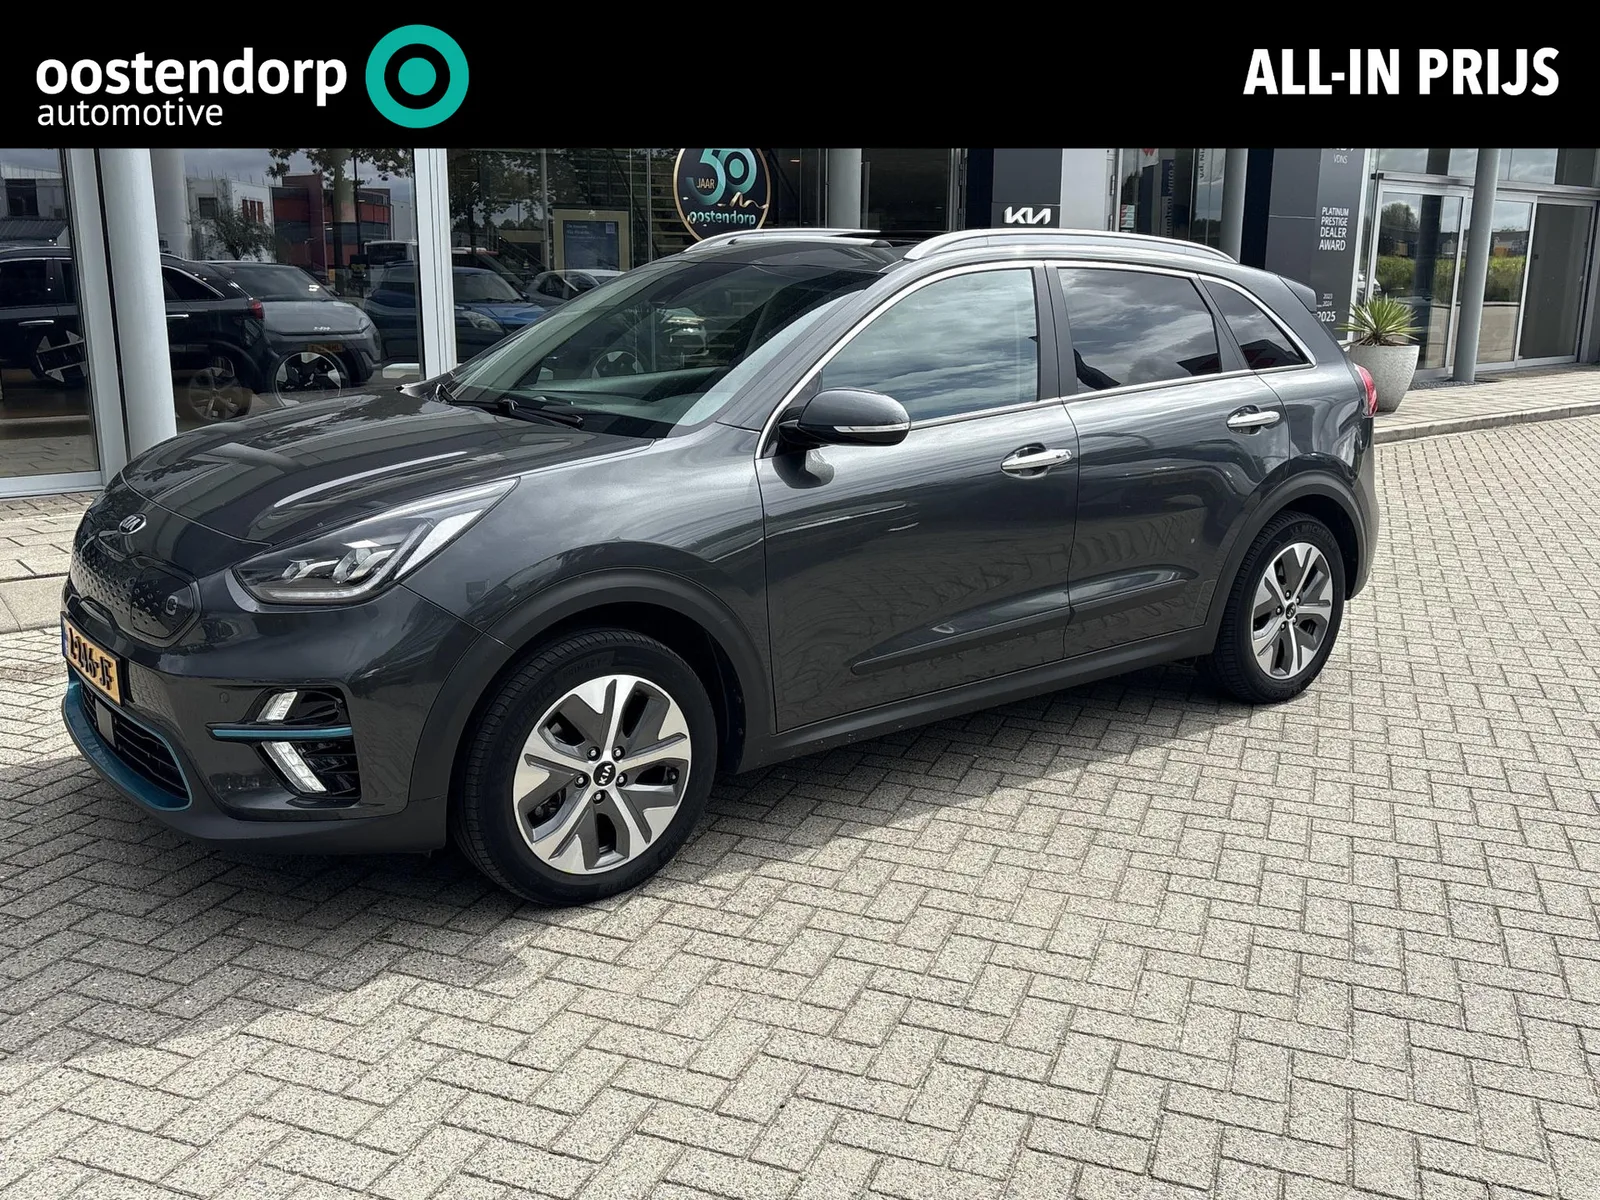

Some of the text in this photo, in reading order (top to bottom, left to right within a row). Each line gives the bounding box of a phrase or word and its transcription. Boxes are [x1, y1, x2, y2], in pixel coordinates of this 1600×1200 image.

[696, 177, 715, 190] JAAR
[688, 210, 756, 225] oostendorp
[1004, 206, 1051, 225] KIA
[1321, 207, 1349, 217] PLATINUM
[1320, 217, 1348, 227] PRESTIGE
[1320, 227, 1347, 238] DEALER
[1318, 239, 1346, 251] AWARD
[598, 765, 612, 784] KIA
